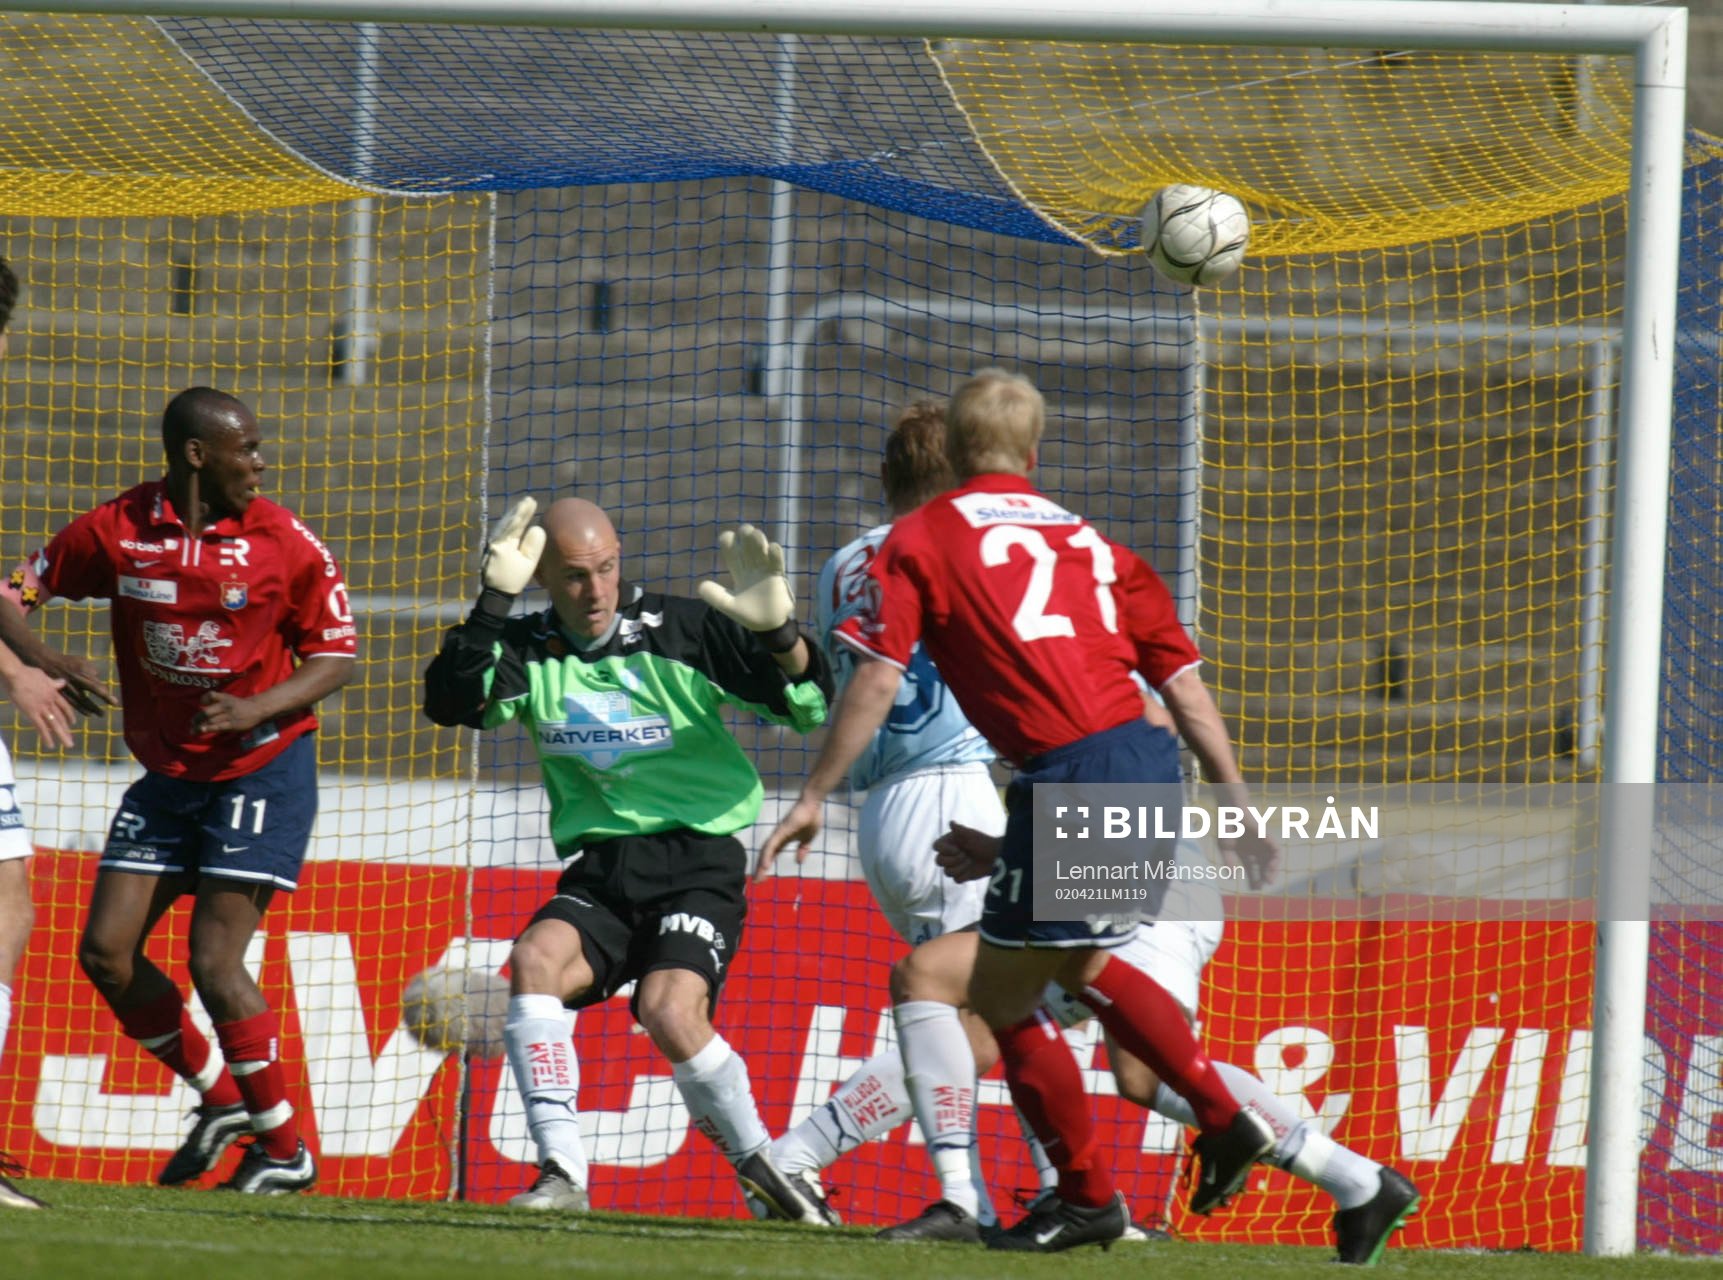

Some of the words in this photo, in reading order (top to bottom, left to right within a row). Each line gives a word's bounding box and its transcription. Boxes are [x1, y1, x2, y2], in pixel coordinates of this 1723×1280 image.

[979, 524, 1120, 643] 21
[537, 725, 670, 745] NÄTVERKET
[231, 794, 267, 835] 11
[658, 912, 714, 943] MVB
[525, 1042, 554, 1088] TEAM
[551, 1041, 570, 1086] SPORTIA
[932, 1085, 957, 1133] TEAM
